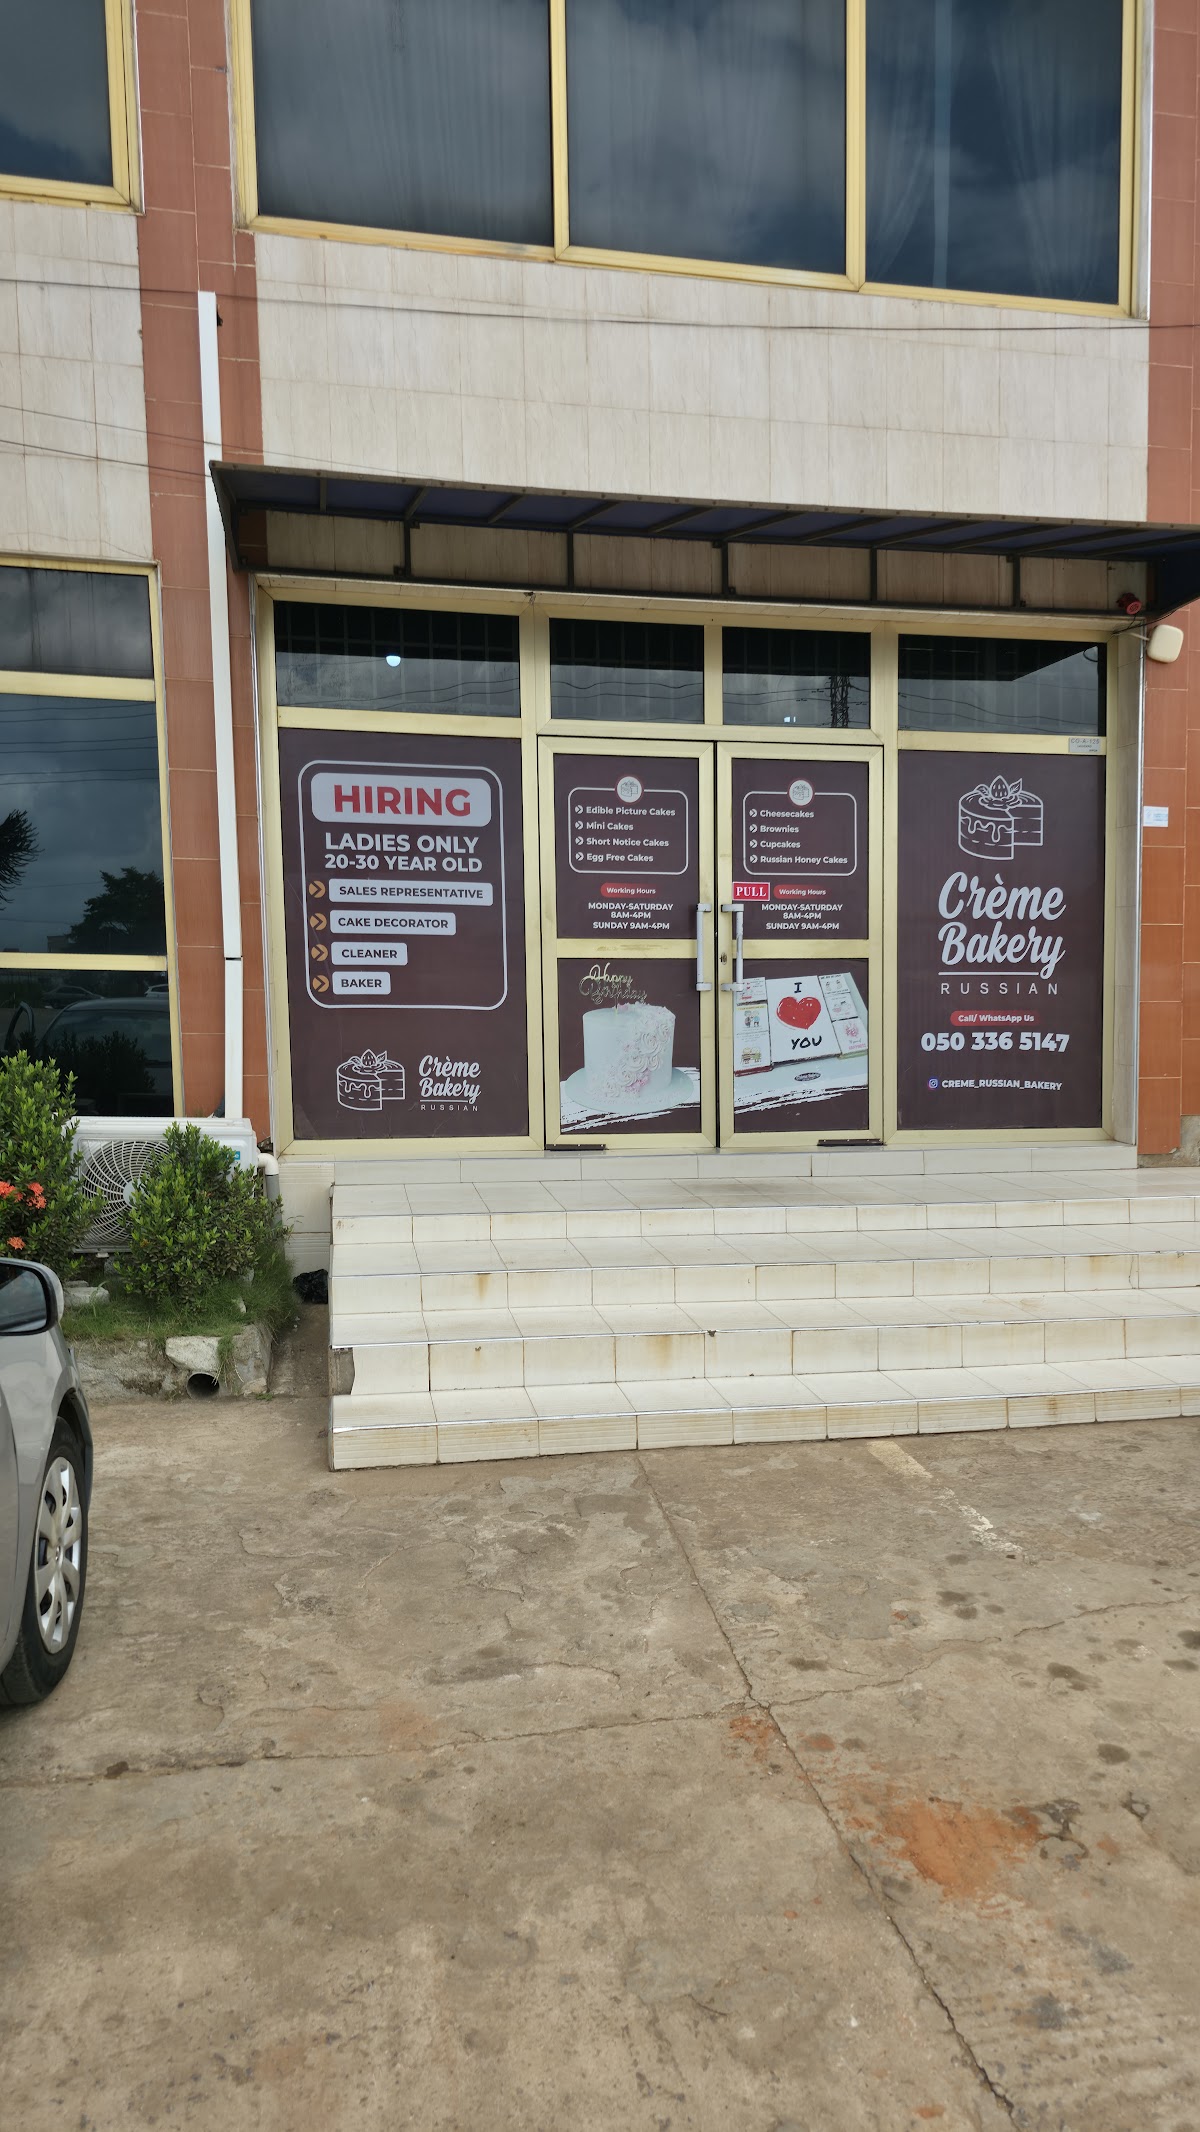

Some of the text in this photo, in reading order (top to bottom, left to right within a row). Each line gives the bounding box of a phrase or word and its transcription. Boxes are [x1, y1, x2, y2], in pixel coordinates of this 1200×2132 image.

[334, 784, 471, 817] HIRING
[586, 806, 676, 816] Edible Picture Cakes
[760, 810, 814, 818] Cheesecakes
[586, 822, 634, 830] Mini Cakes
[760, 825, 799, 833] Brownies
[325, 832, 479, 854] LADIES ONLY
[586, 838, 670, 847] Short Notice Cakes
[760, 840, 800, 850] Cupcakes
[324, 854, 482, 872] 20-30 YEAR OLD
[586, 853, 604, 862] Egg
[628, 854, 654, 862] Cakes
[760, 856, 848, 865] Russian Honey Cakes
[340, 886, 484, 898] SALES REPRESENTATIVE
[606, 887, 635, 895] Working
[736, 886, 766, 896] PULL
[938, 871, 1066, 921] Crème
[588, 902, 674, 910] MONDAY-SATURDAY
[338, 917, 448, 928] CAKE DECORATOR
[342, 949, 398, 958] CLEANER
[938, 920, 1066, 980] Bakery
[589, 962, 634, 988] Happy
[341, 978, 382, 988] BAKER
[794, 982, 802, 994] I
[940, 982, 1058, 995] RUSSIAN
[958, 1014, 978, 1023] Call/
[979, 1014, 1022, 1024] WhatsApp
[791, 1036, 822, 1050] YOU
[920, 1032, 1070, 1053] 050 336 5147
[418, 1054, 481, 1078] Crème
[418, 1077, 482, 1104] Bakery
[942, 1079, 1062, 1091] CREME_RUSSIAN_BAKERY
